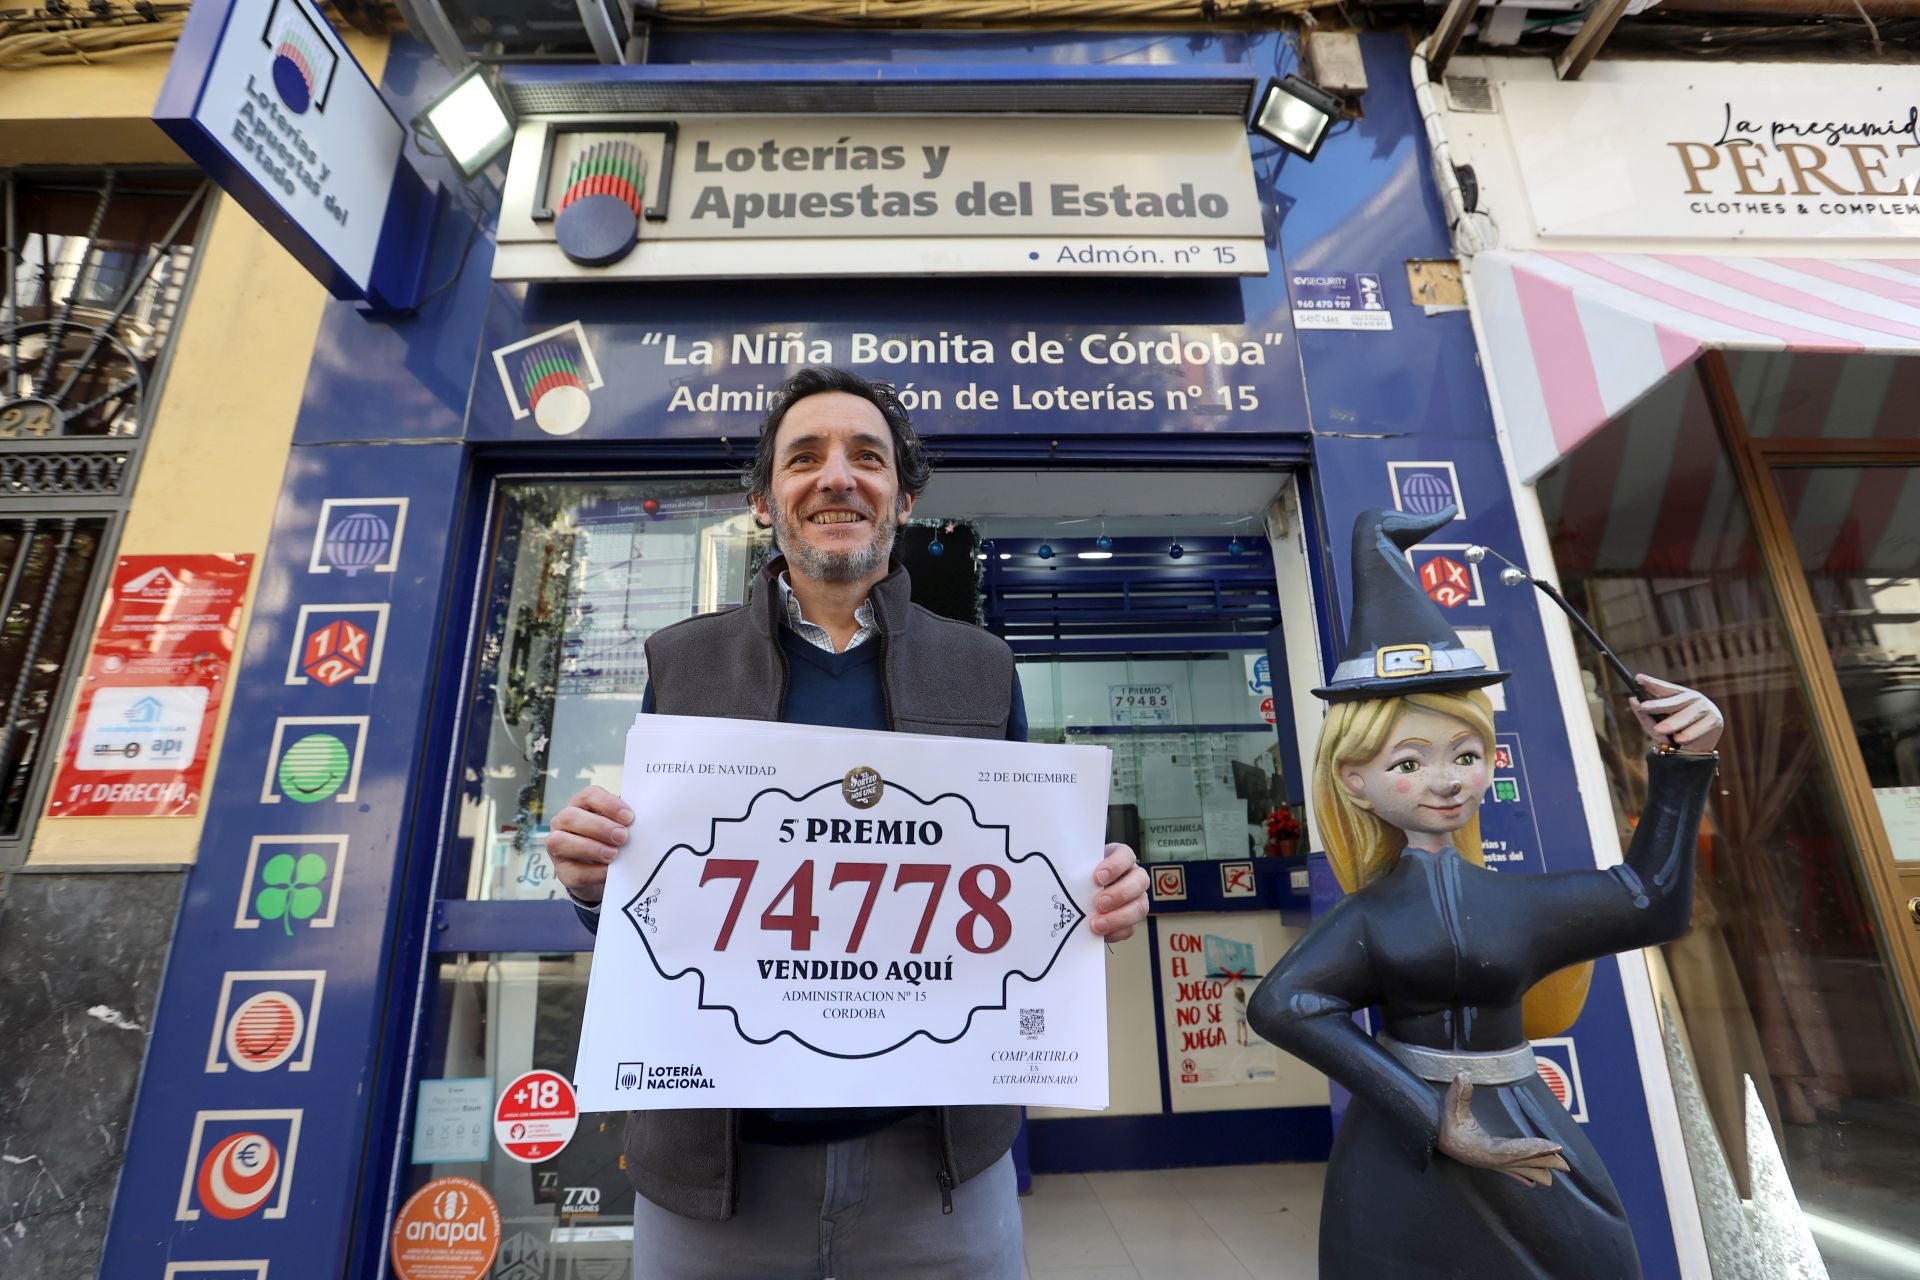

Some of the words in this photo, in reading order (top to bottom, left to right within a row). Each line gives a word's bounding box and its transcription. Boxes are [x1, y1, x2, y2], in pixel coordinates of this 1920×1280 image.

[246, 74, 317, 165] Loterías
[318, 163, 331, 182] y
[1714, 102, 1762, 147] La
[1771, 106, 1920, 151] presumid
[231, 119, 296, 196] Estado
[238, 100, 321, 197] Apuestas
[324, 194, 348, 227] del
[694, 136, 906, 173] Loterías
[921, 145, 951, 179] y
[690, 183, 938, 229] Apuestas
[955, 181, 1033, 217] del
[1050, 182, 1230, 219] Estado
[1690, 202, 1786, 214] CLOTHES
[1797, 203, 1810, 215] &
[1056, 245, 1164, 264] Admón.
[1174, 245, 1201, 264] nº
[1212, 246, 1237, 264] 15
[1297, 300, 1314, 309] 960
[1316, 300, 1333, 309] 470
[1335, 300, 1351, 309] 959
[731, 331, 833, 365] Niña
[851, 331, 995, 365] Bonita
[1010, 331, 1064, 364] de
[955, 382, 999, 411] de
[1012, 383, 1154, 411] Loterías
[1167, 385, 1202, 411] nº
[1216, 385, 1259, 412] 15
[0, 407, 52, 437] 24
[1129, 687, 1161, 695] PREMIO
[1115, 696, 1168, 707] 79485
[646, 763, 695, 775] LOTERÍA
[699, 763, 715, 775] DE
[718, 764, 777, 776] NAVIDAD
[977, 771, 990, 782] 22
[993, 772, 1009, 782] DE
[1013, 772, 1078, 783] DICIEMBRE
[849, 775, 877, 789] SORTEO
[91, 782, 187, 803] DERECHA
[851, 791, 862, 800] NOS
[862, 786, 877, 796] UNE
[805, 817, 944, 846] PREMIO
[1150, 823, 1204, 834] VENTANILLA
[1157, 839, 1199, 848] CERRADA
[1509, 851, 1524, 861] del
[516, 852, 549, 888] La
[698, 858, 1013, 955] 74778
[1170, 933, 1202, 953] CON
[757, 959, 879, 981] VENDIDO
[885, 955, 953, 986] AQUÍ
[1172, 957, 1190, 978] EL
[781, 990, 895, 1002] ADMINISTRACION
[897, 990, 912, 1002] Nº
[914, 991, 927, 1002] 15
[1176, 981, 1223, 1003] JUEGO
[822, 1008, 886, 1019] CORDOBA
[1176, 1006, 1200, 1026] NO
[1206, 1003, 1223, 1024] SE
[1180, 1027, 1227, 1052] JUEGA
[991, 1050, 1079, 1062] COMPARTIRLO
[648, 1064, 703, 1077] LOTERÍA
[992, 1075, 1078, 1085] EXTRAORDINARIO
[647, 1078, 716, 1090] NACIONAL
[514, 1080, 560, 1110] +18
[564, 1187, 601, 1205] 770
[562, 1205, 600, 1213] MILLONES
[405, 1216, 488, 1248] anapal
